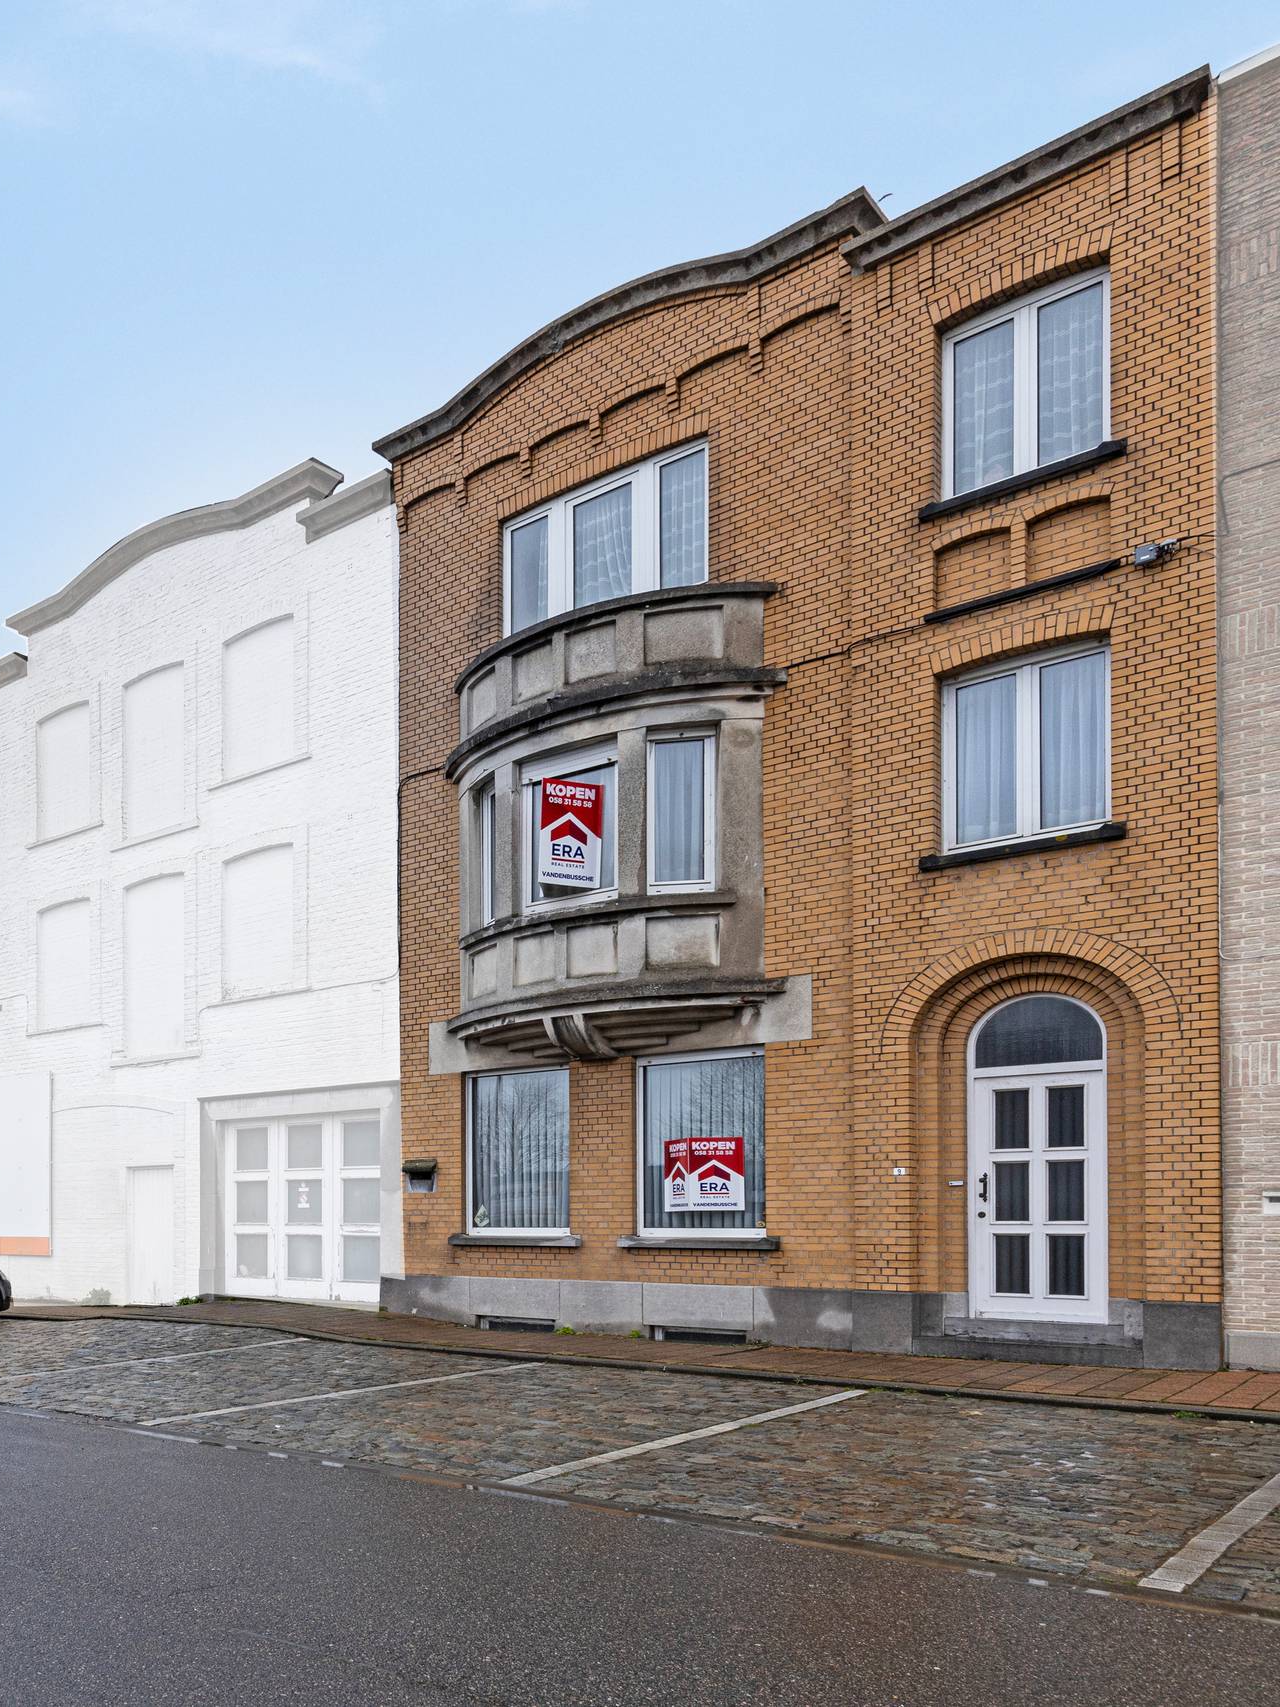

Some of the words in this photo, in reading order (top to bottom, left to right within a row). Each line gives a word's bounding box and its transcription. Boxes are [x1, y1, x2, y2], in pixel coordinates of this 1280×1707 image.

[546, 783, 596, 800] KOPEN
[548, 796, 563, 804] 058
[572, 799, 582, 807] 58
[552, 843, 585, 859] ERA
[542, 871, 594, 882] VANDENBUSSCHE
[692, 1142, 736, 1150] KOPEN
[672, 1183, 685, 1193] ERA
[700, 1182, 730, 1191] ERA
